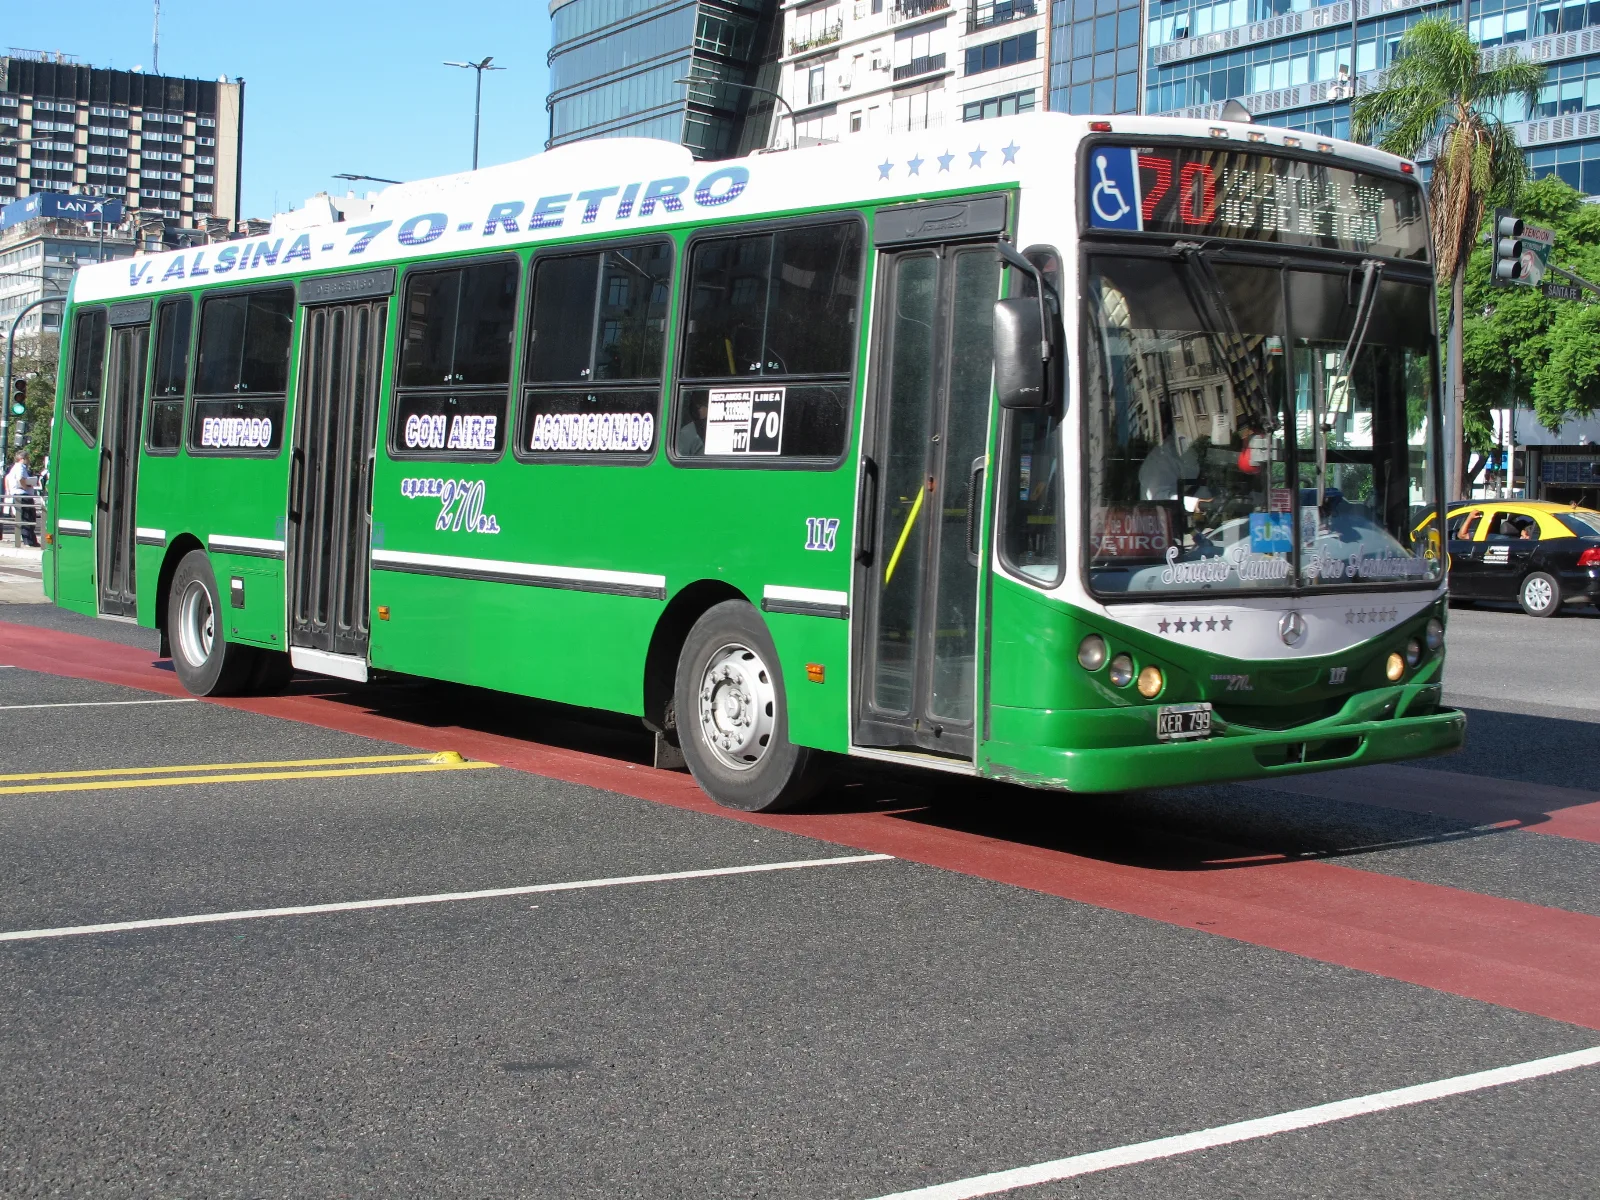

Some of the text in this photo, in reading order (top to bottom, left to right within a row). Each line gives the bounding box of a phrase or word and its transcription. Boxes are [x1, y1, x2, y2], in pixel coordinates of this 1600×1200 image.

[1137, 155, 1216, 225] 70
[1223, 168, 1385, 214] VALENTIN ALSINA
[57, 201, 87, 212] LAN
[1262, 203, 1291, 231] DE
[1298, 208, 1377, 241] RETIRO
[1548, 284, 1578, 299] SANTA FE
[754, 393, 781, 402] LINEA
[202, 418, 272, 448] EQUIPADO
[405, 414, 497, 450] CON AIRE
[531, 413, 654, 451] ACONDICIONADO
[733, 432, 748, 449] 117
[753, 411, 780, 438] 70
[436, 479, 485, 533] 270
[805, 517, 840, 552] 117
[1090, 535, 1168, 550] RETIRO
[1160, 546, 1229, 585] Servicio
[1160, 711, 1210, 733] KER 799
